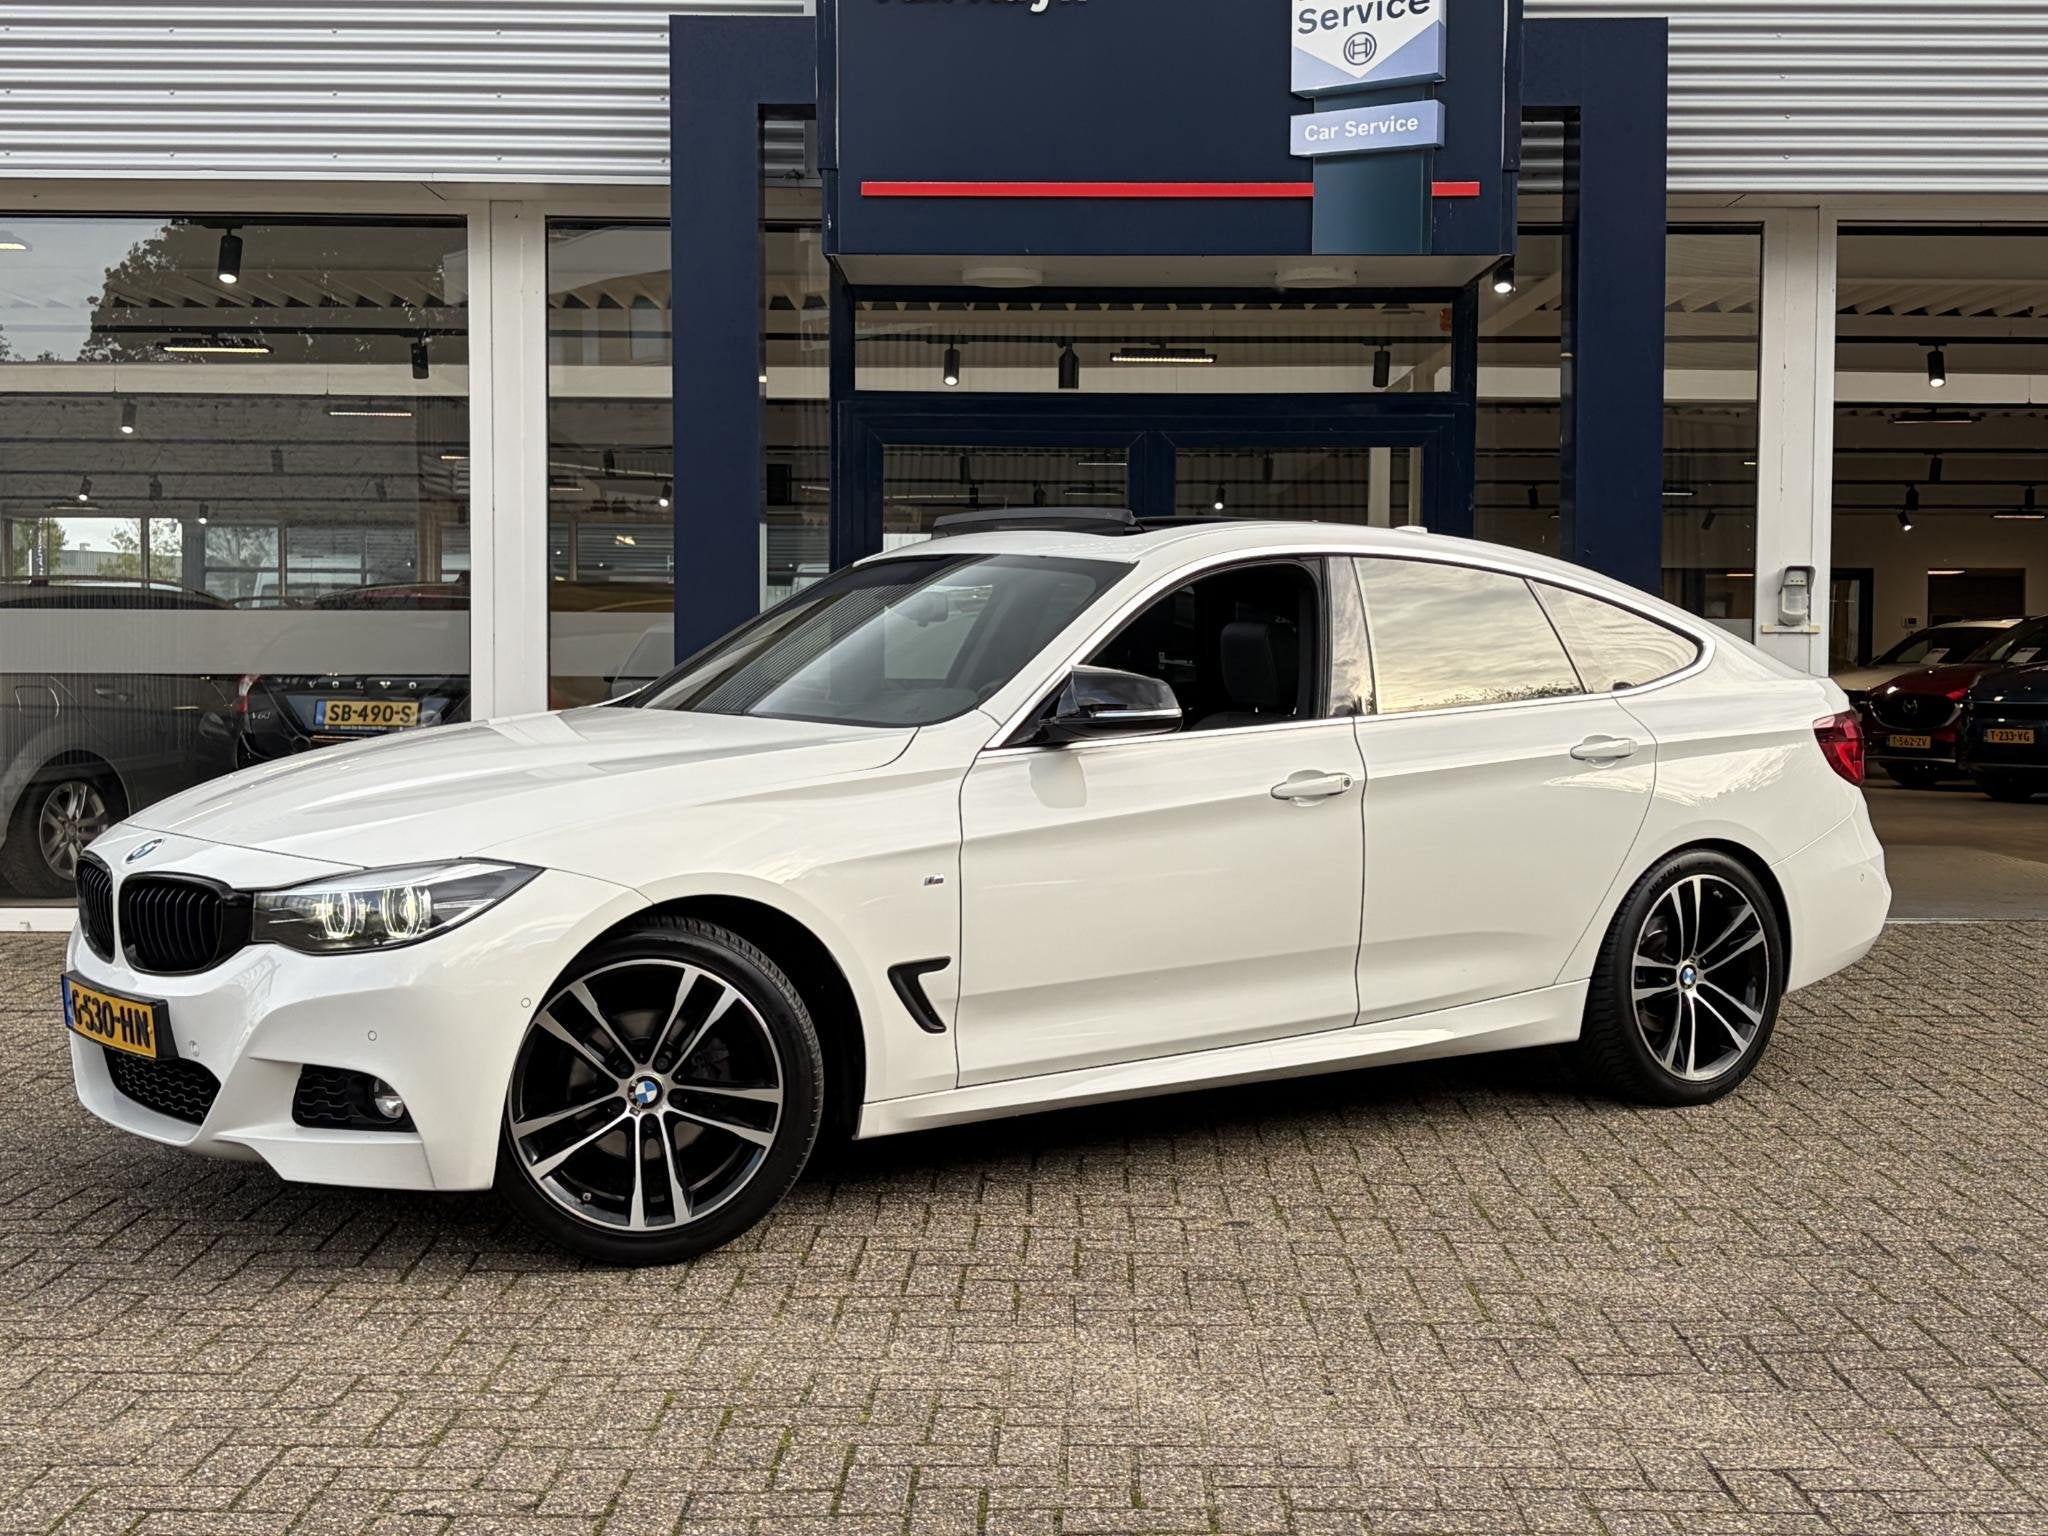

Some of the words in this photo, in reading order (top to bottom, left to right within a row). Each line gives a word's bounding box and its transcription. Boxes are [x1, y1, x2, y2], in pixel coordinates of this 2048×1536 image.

[1298, 0, 1430, 35] Service
[1304, 124, 1338, 141] Car
[1345, 115, 1419, 137] Service
[328, 704, 412, 724] SB-490-S
[72, 989, 150, 1049] G-530-HN
